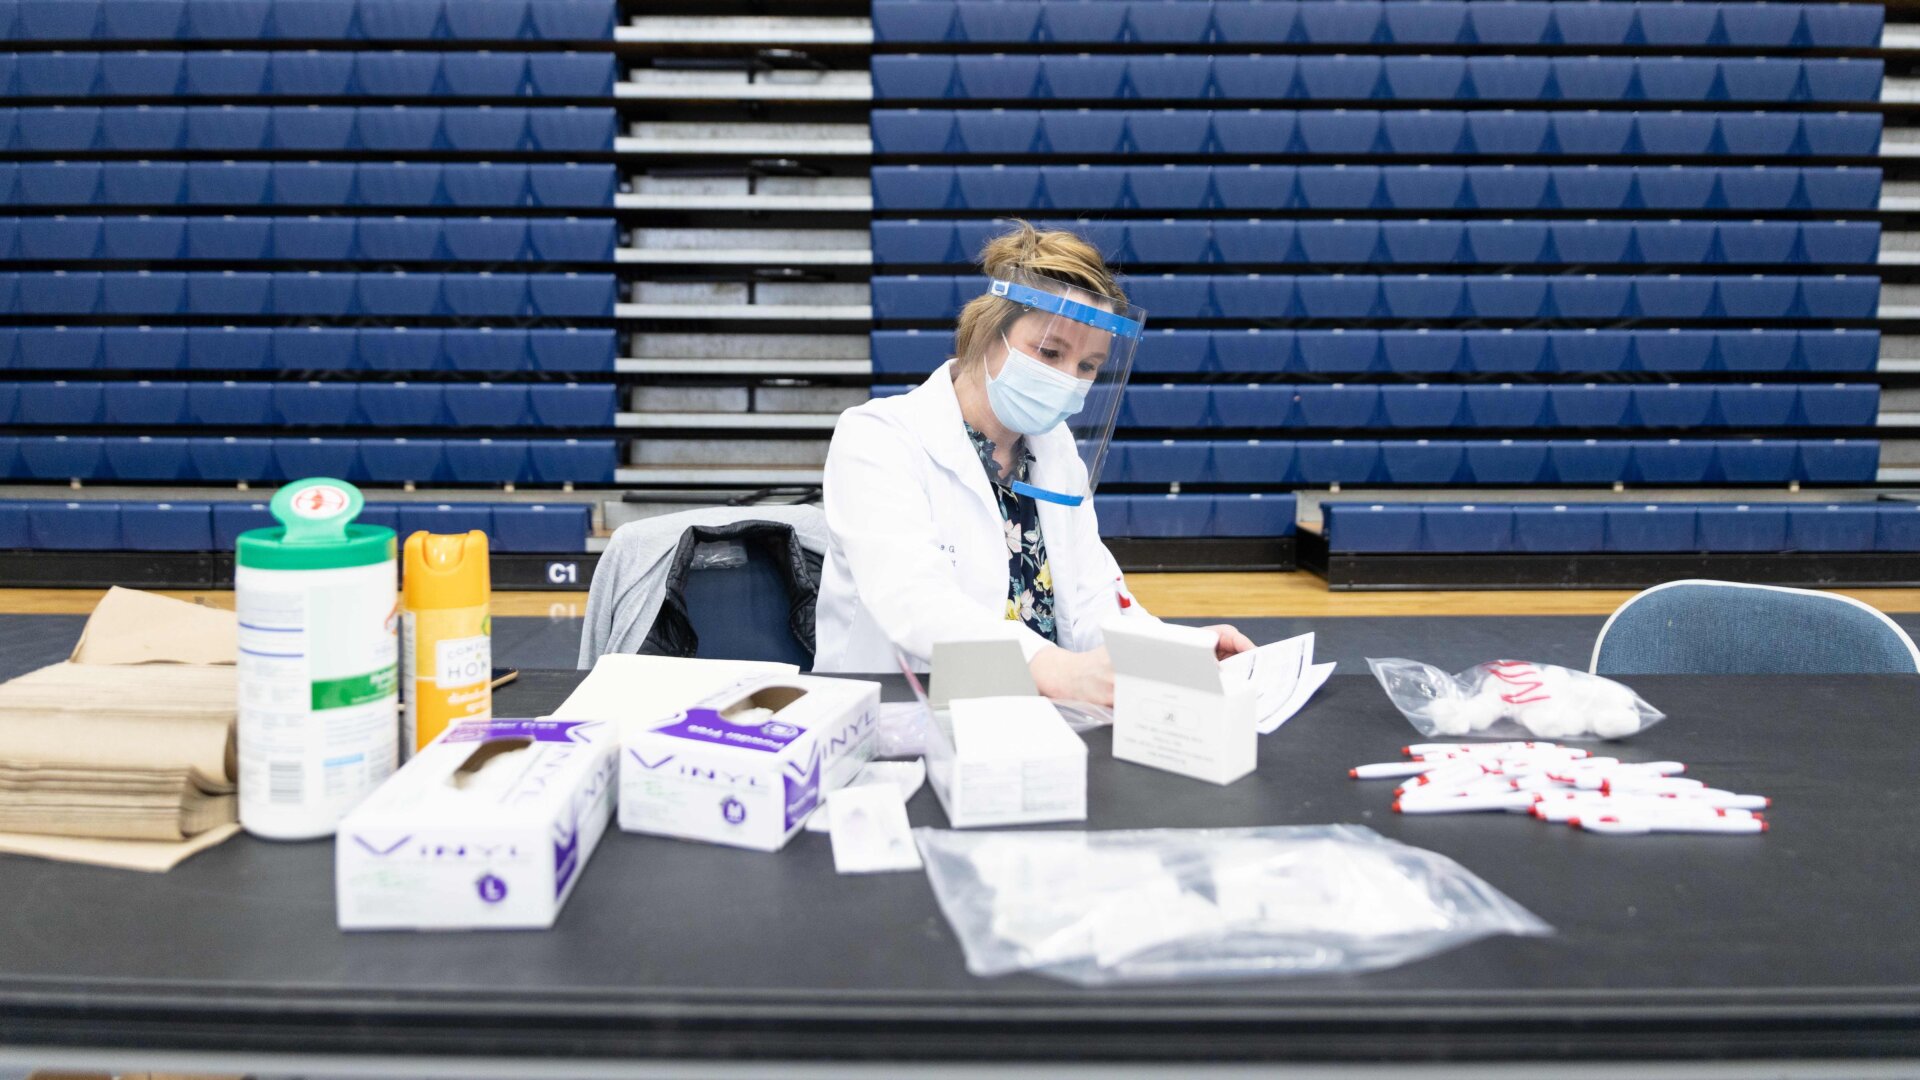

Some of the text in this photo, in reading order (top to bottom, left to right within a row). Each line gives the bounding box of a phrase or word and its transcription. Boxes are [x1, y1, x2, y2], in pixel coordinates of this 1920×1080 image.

[549, 563, 576, 583] C1
[521, 722, 559, 730] Free
[788, 710, 876, 778] VINYL
[628, 747, 762, 786] VINYL
[351, 834, 518, 857] VINYL
